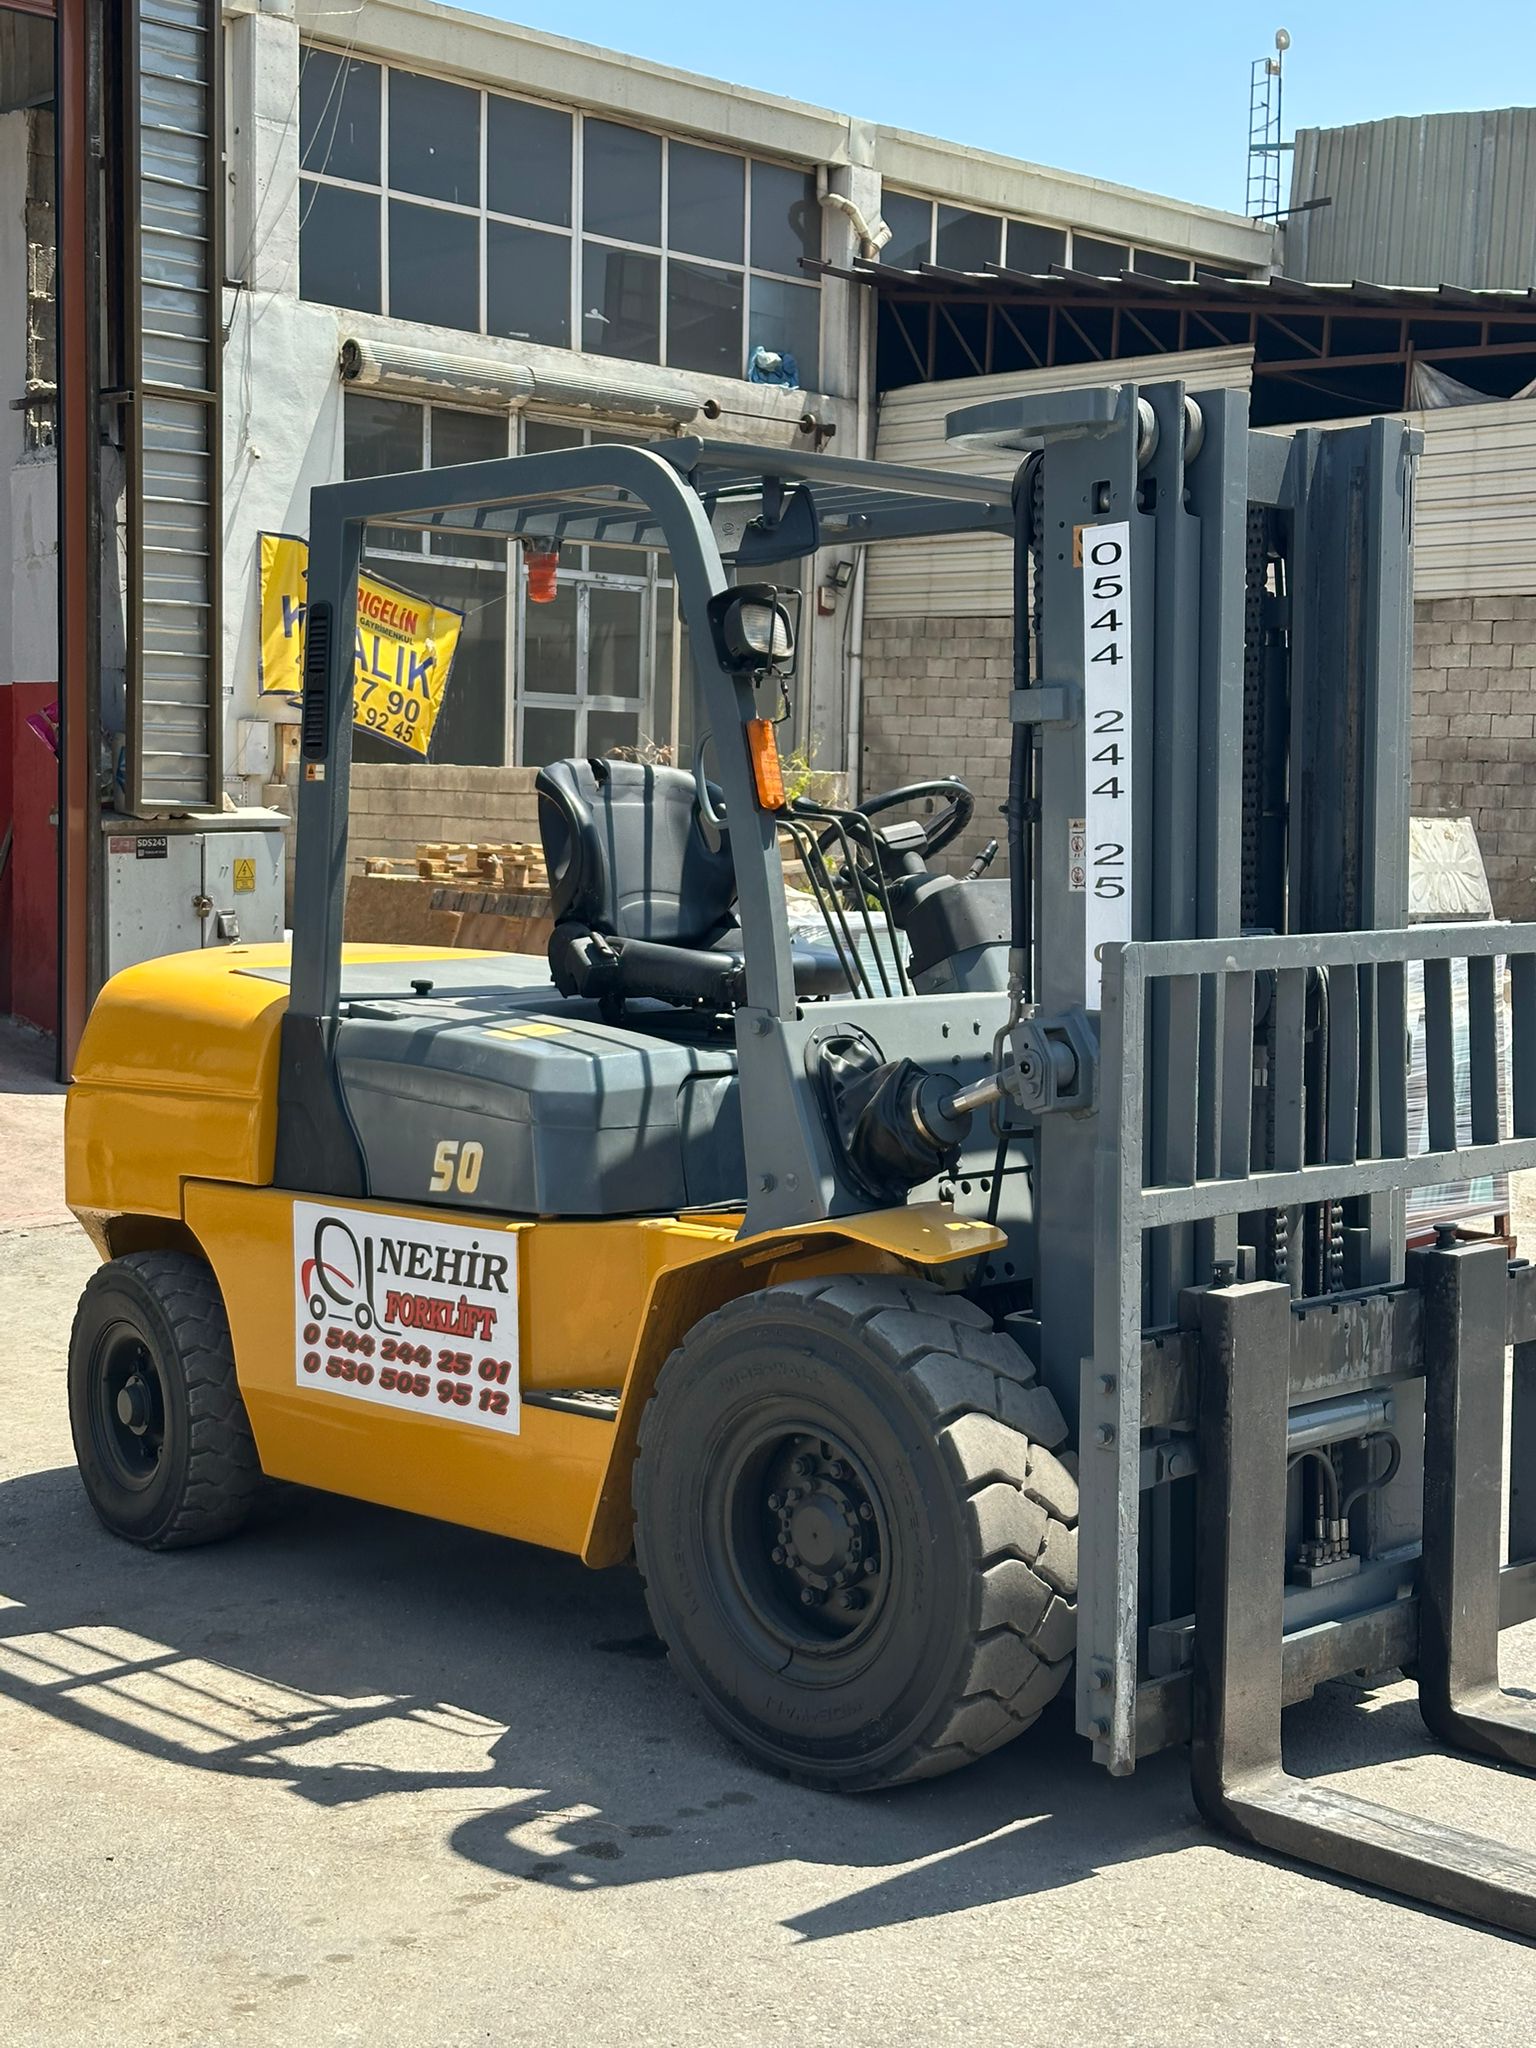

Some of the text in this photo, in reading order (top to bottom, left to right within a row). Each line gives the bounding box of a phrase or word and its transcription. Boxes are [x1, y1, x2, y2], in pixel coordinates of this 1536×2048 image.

[387, 690, 421, 723] 90
[392, 721, 416, 743] 45
[137, 838, 167, 847] SDS243
[429, 1140, 484, 1193] 50
[377, 1237, 509, 1294] NEHİR
[384, 1290, 498, 1342] FORKLİFT
[303, 1322, 512, 1385] 0 544 244 25 01
[303, 1351, 511, 1416] 0 530 505 95 12
